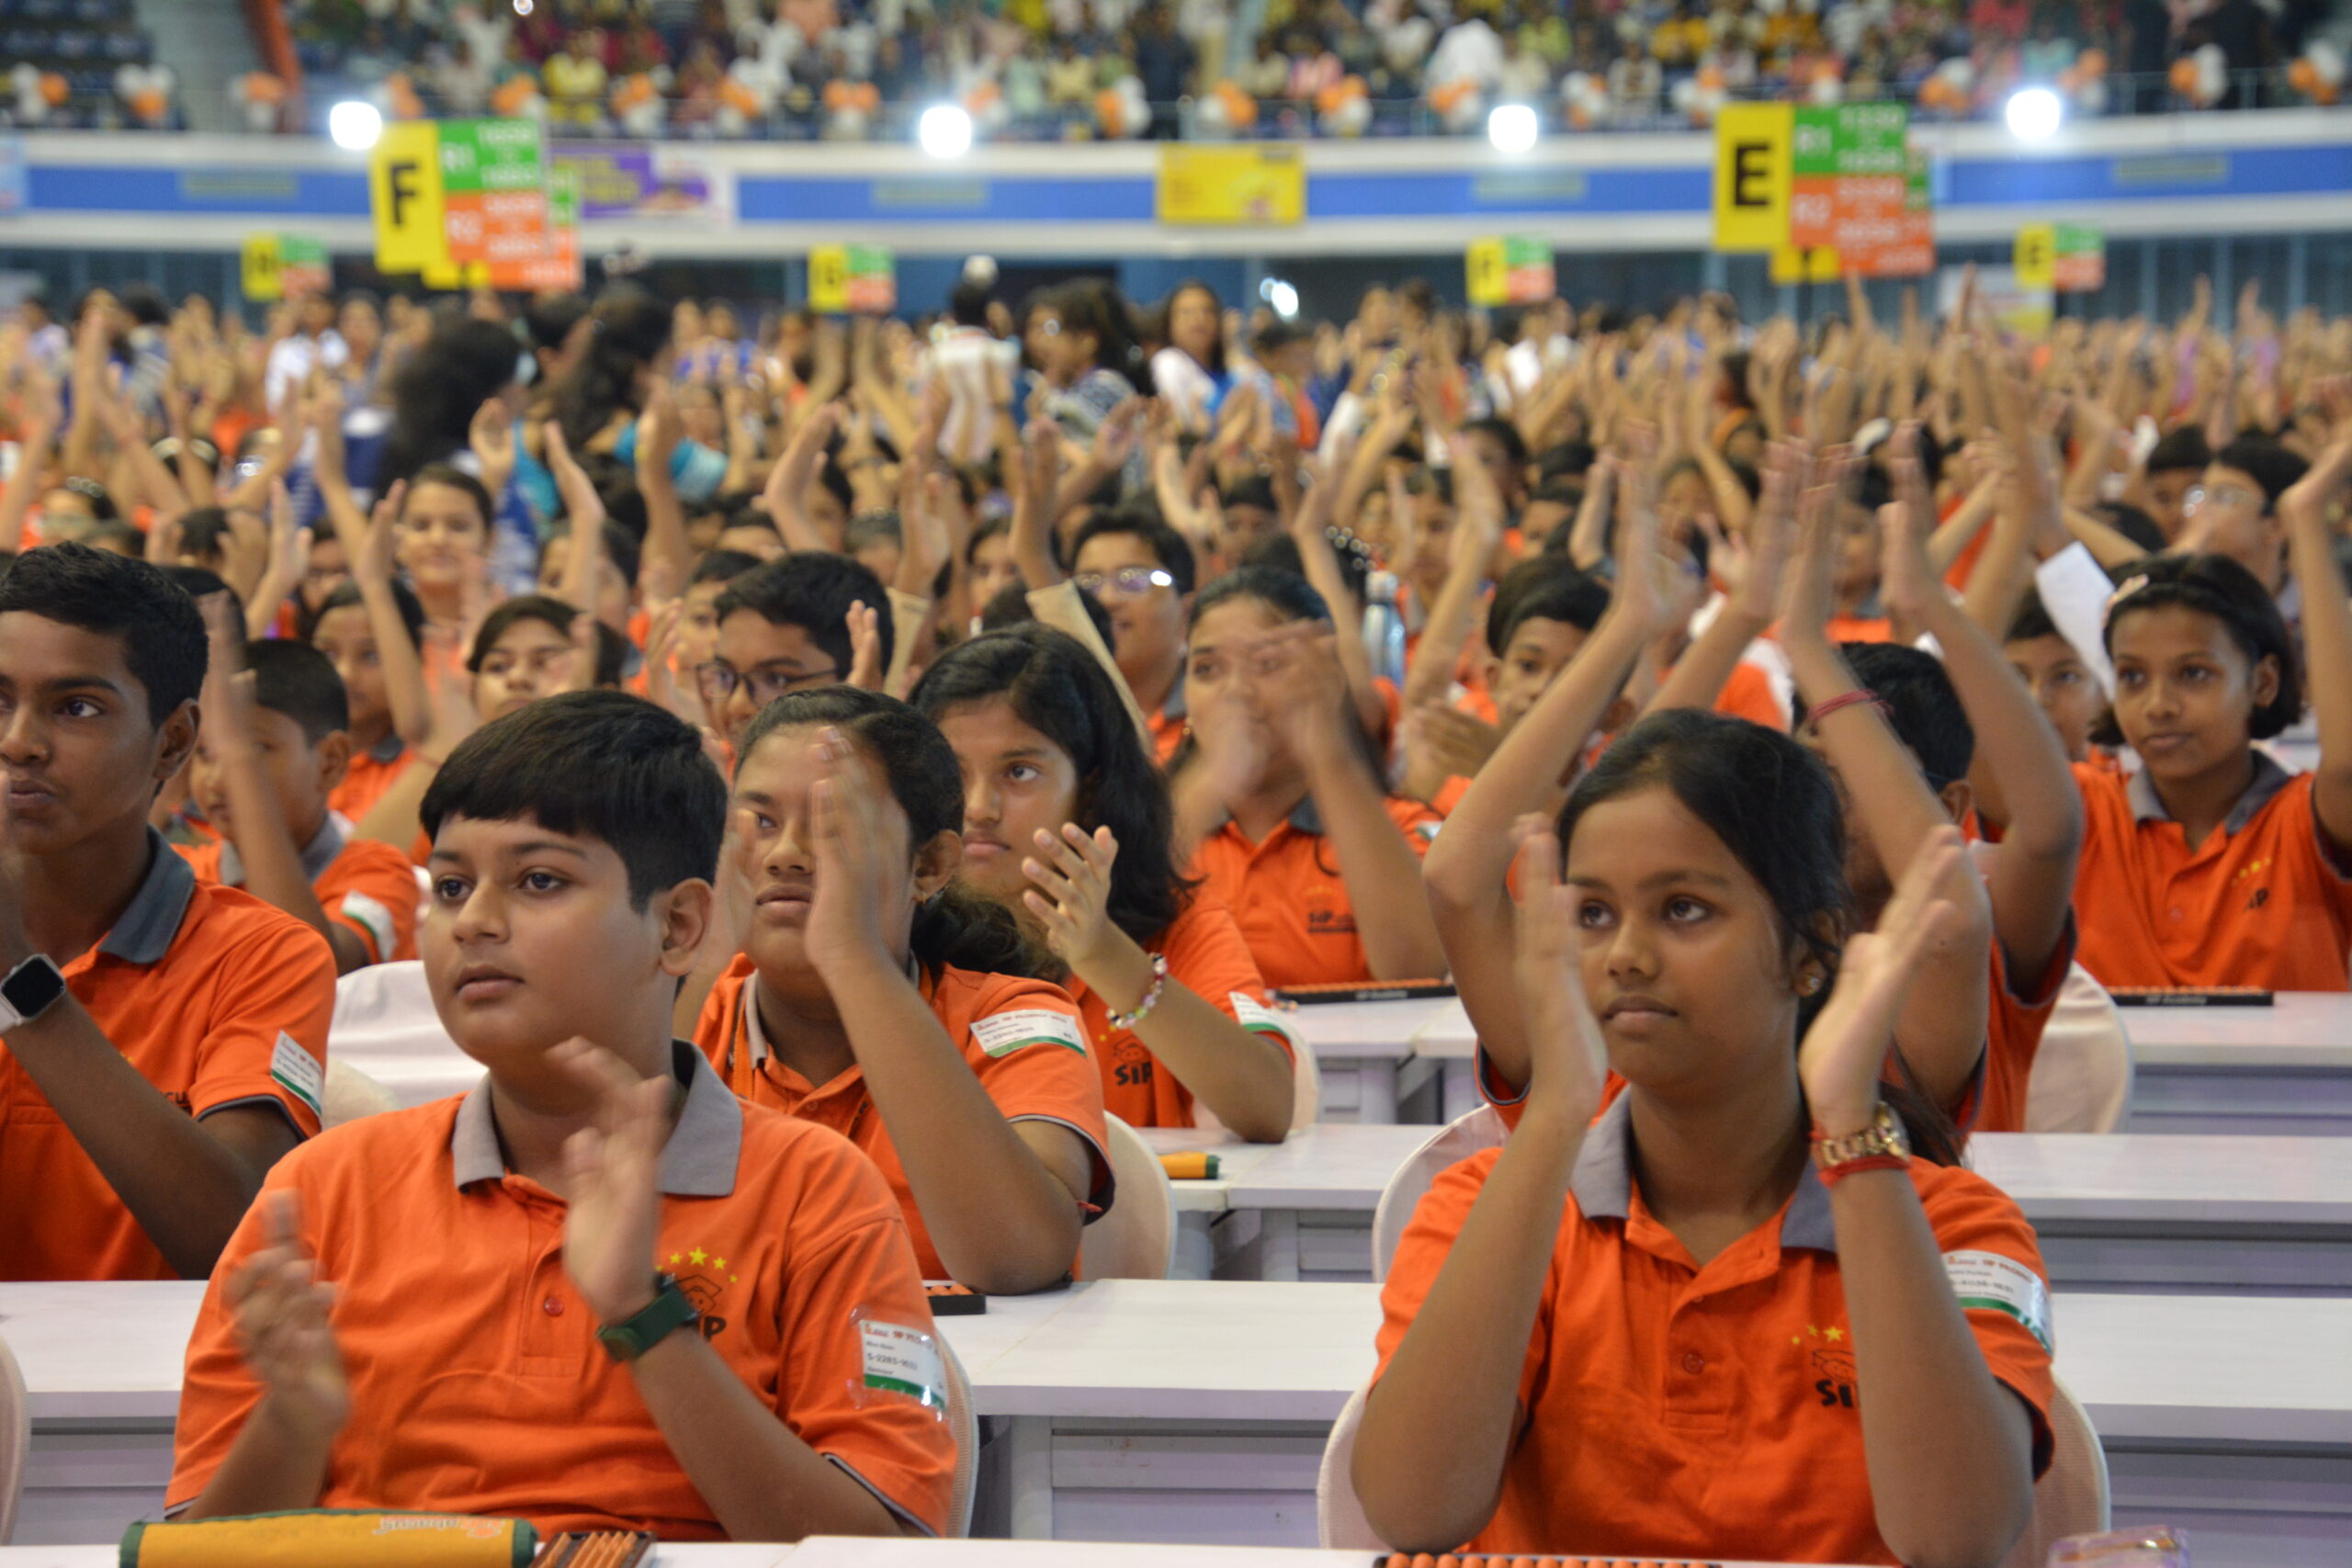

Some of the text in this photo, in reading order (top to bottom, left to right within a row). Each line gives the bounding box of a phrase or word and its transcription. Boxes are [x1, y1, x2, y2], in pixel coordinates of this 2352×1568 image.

[390, 162, 419, 226] F
[1734, 142, 1771, 207] E
[1114, 1062, 1152, 1086] SIP
[1815, 1379, 1854, 1408] SI
